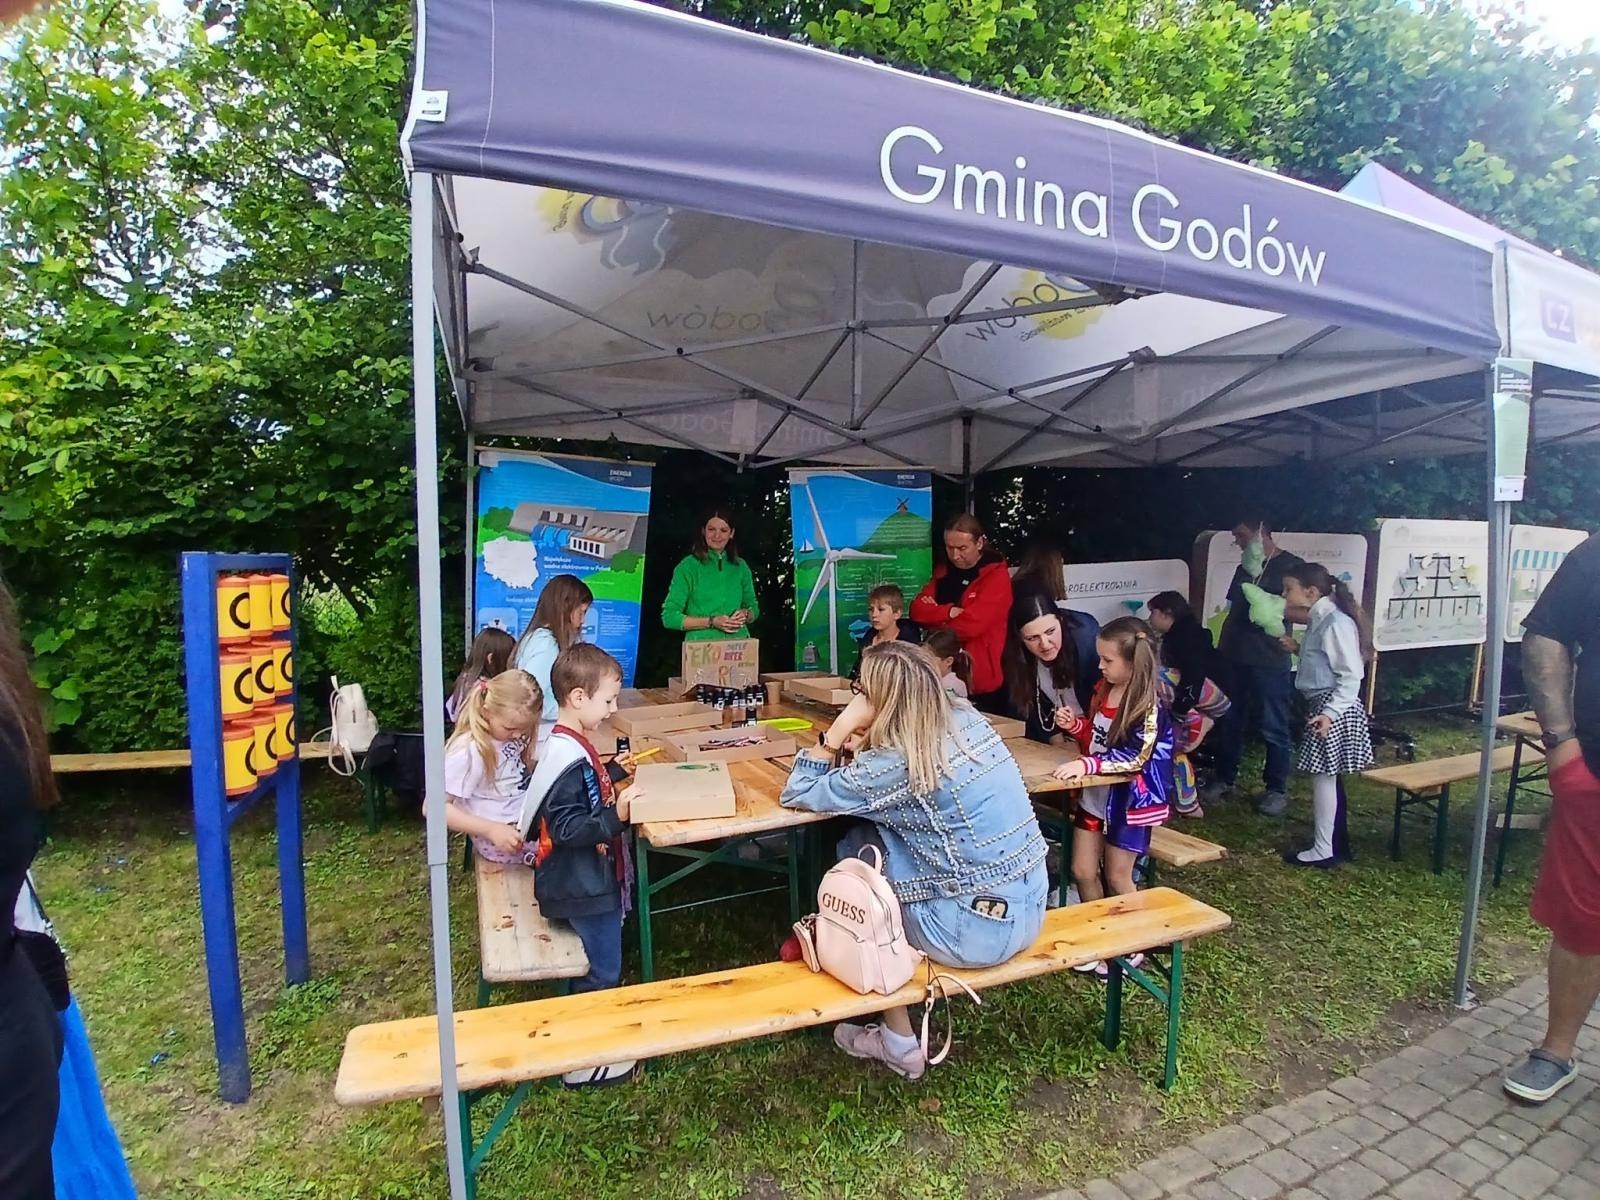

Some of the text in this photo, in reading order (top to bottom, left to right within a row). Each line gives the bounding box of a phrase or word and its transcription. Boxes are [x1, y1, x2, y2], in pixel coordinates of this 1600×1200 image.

[879, 125, 1327, 287] Gmina Godów
[1544, 299, 1572, 334] CZ
[1067, 580, 1137, 593] ROELEKTROWNIA
[822, 892, 866, 925] GUESS
